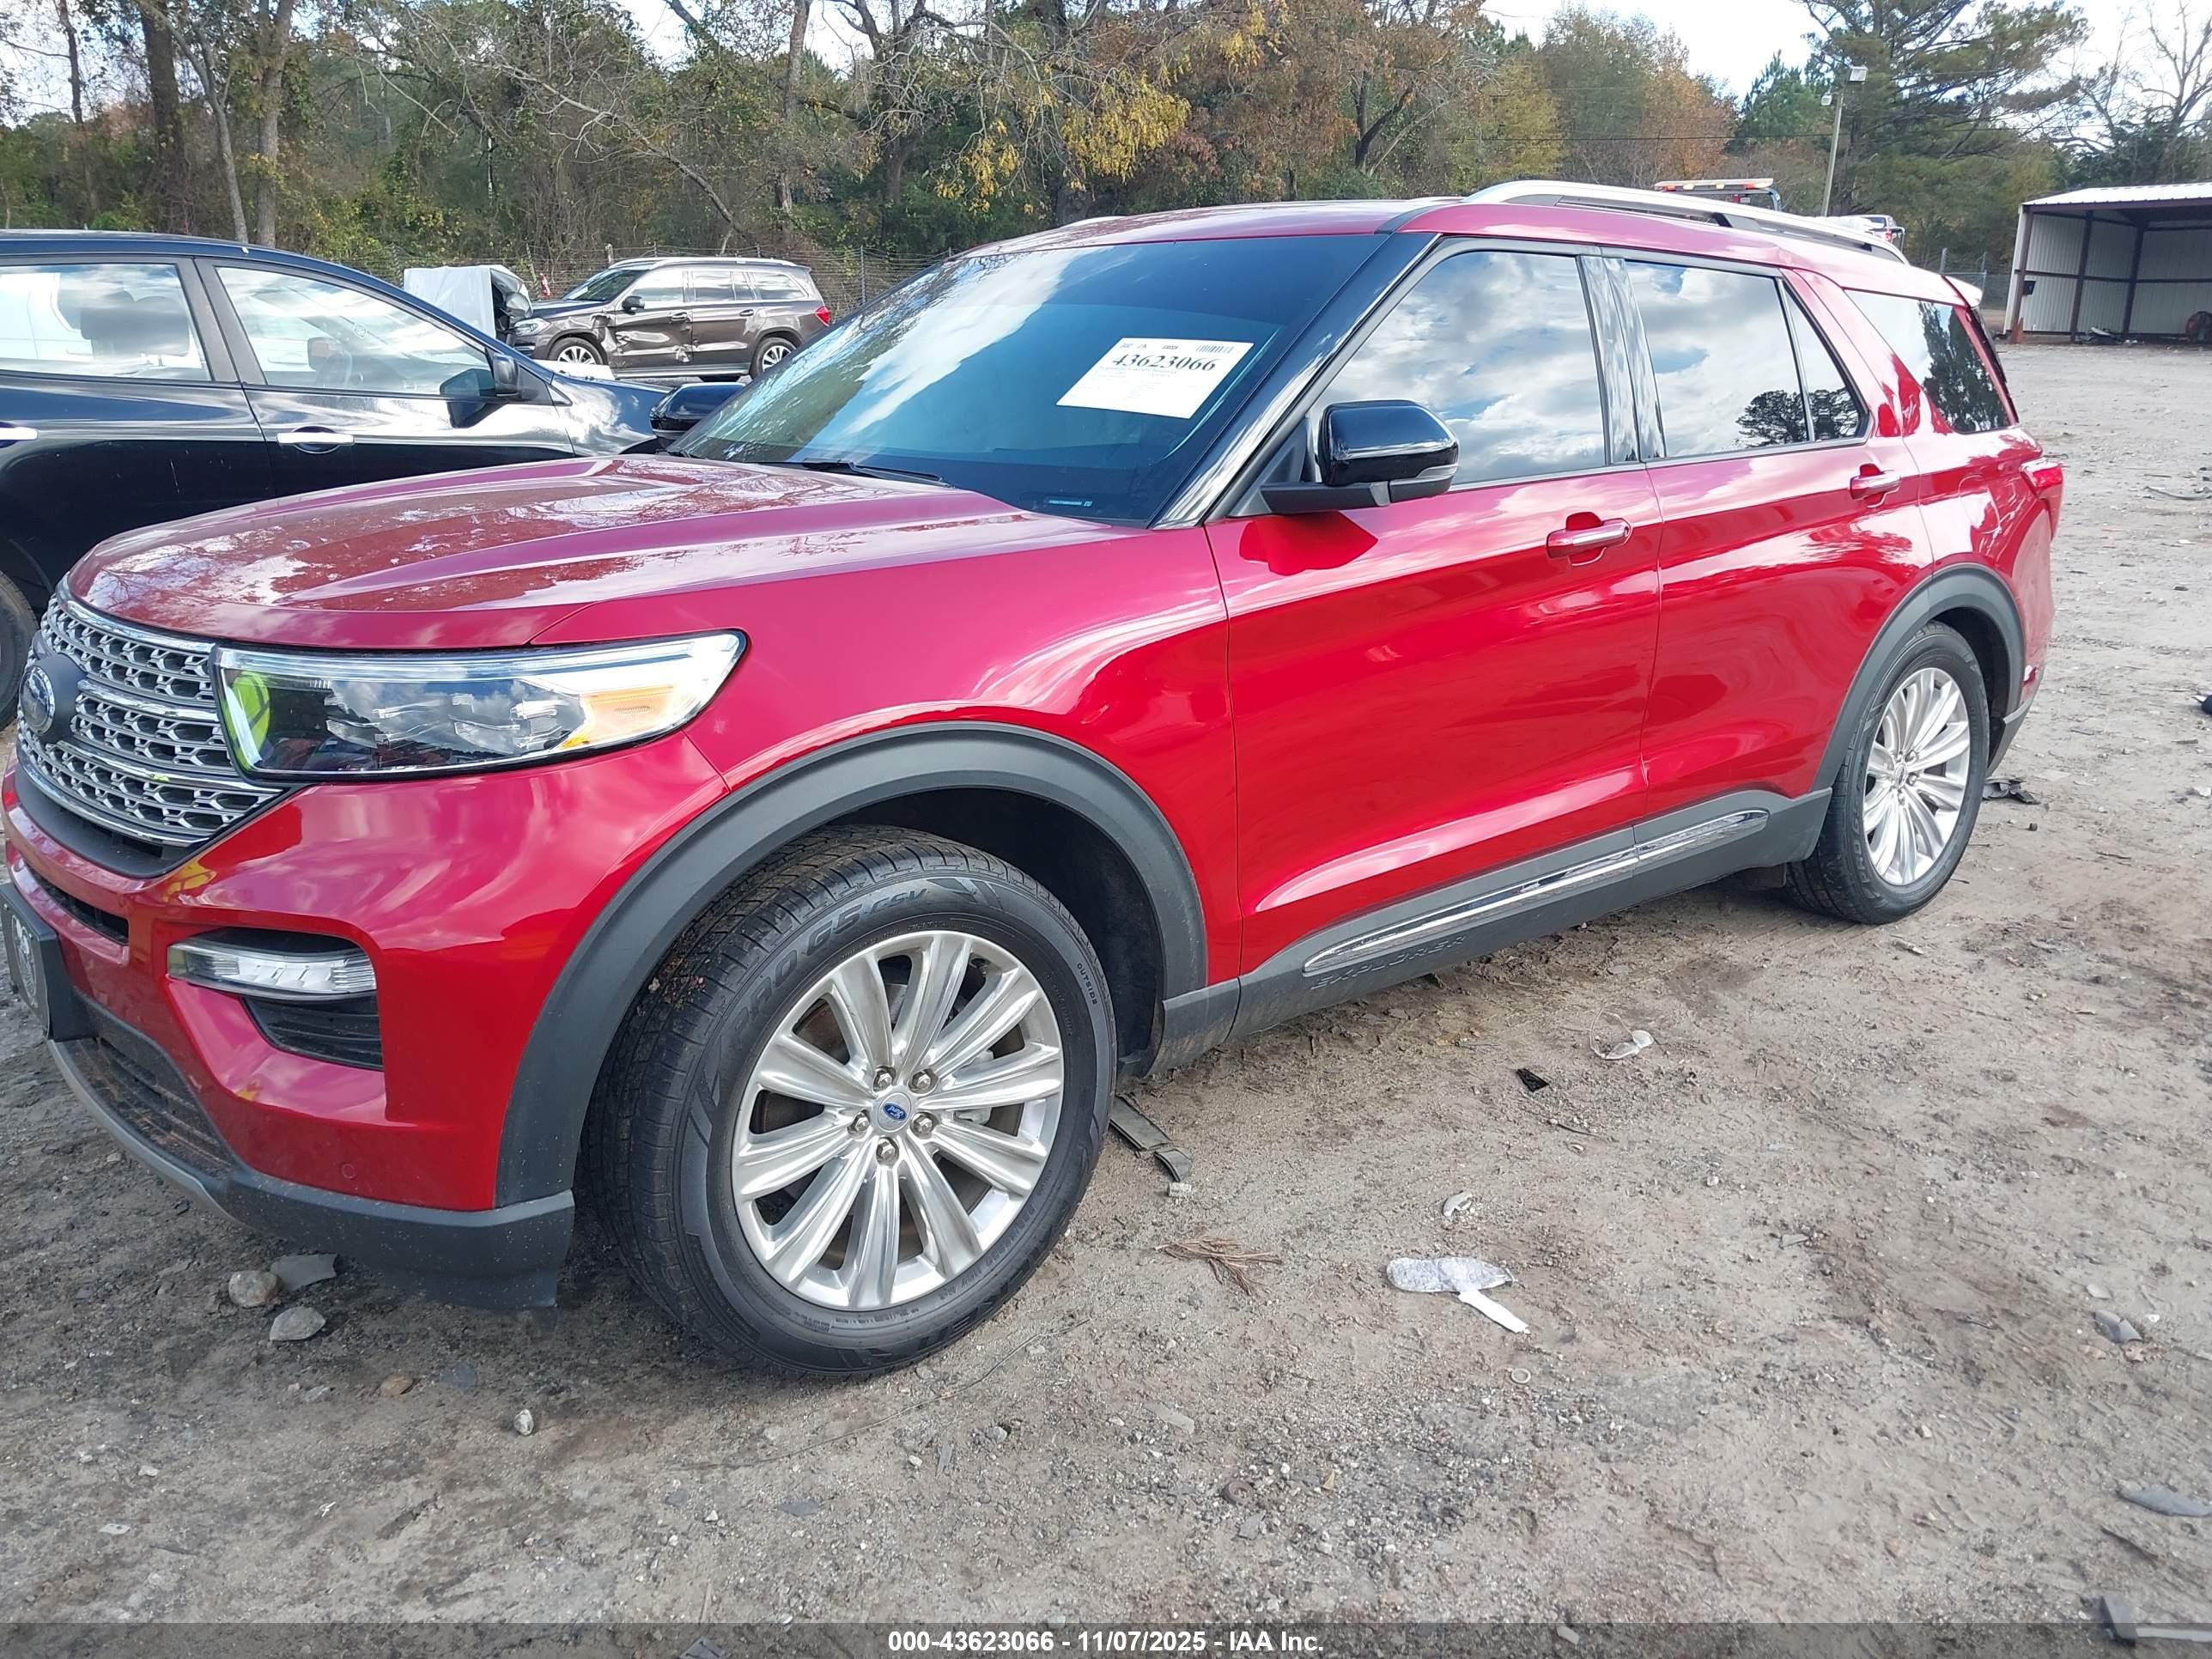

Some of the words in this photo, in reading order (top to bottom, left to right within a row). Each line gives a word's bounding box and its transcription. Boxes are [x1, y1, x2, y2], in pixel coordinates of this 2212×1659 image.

[1113, 353, 1220, 372] 43623066
[1075, 961, 1098, 1006] OUTSIDE
[1311, 936, 1467, 990] EXPLORER
